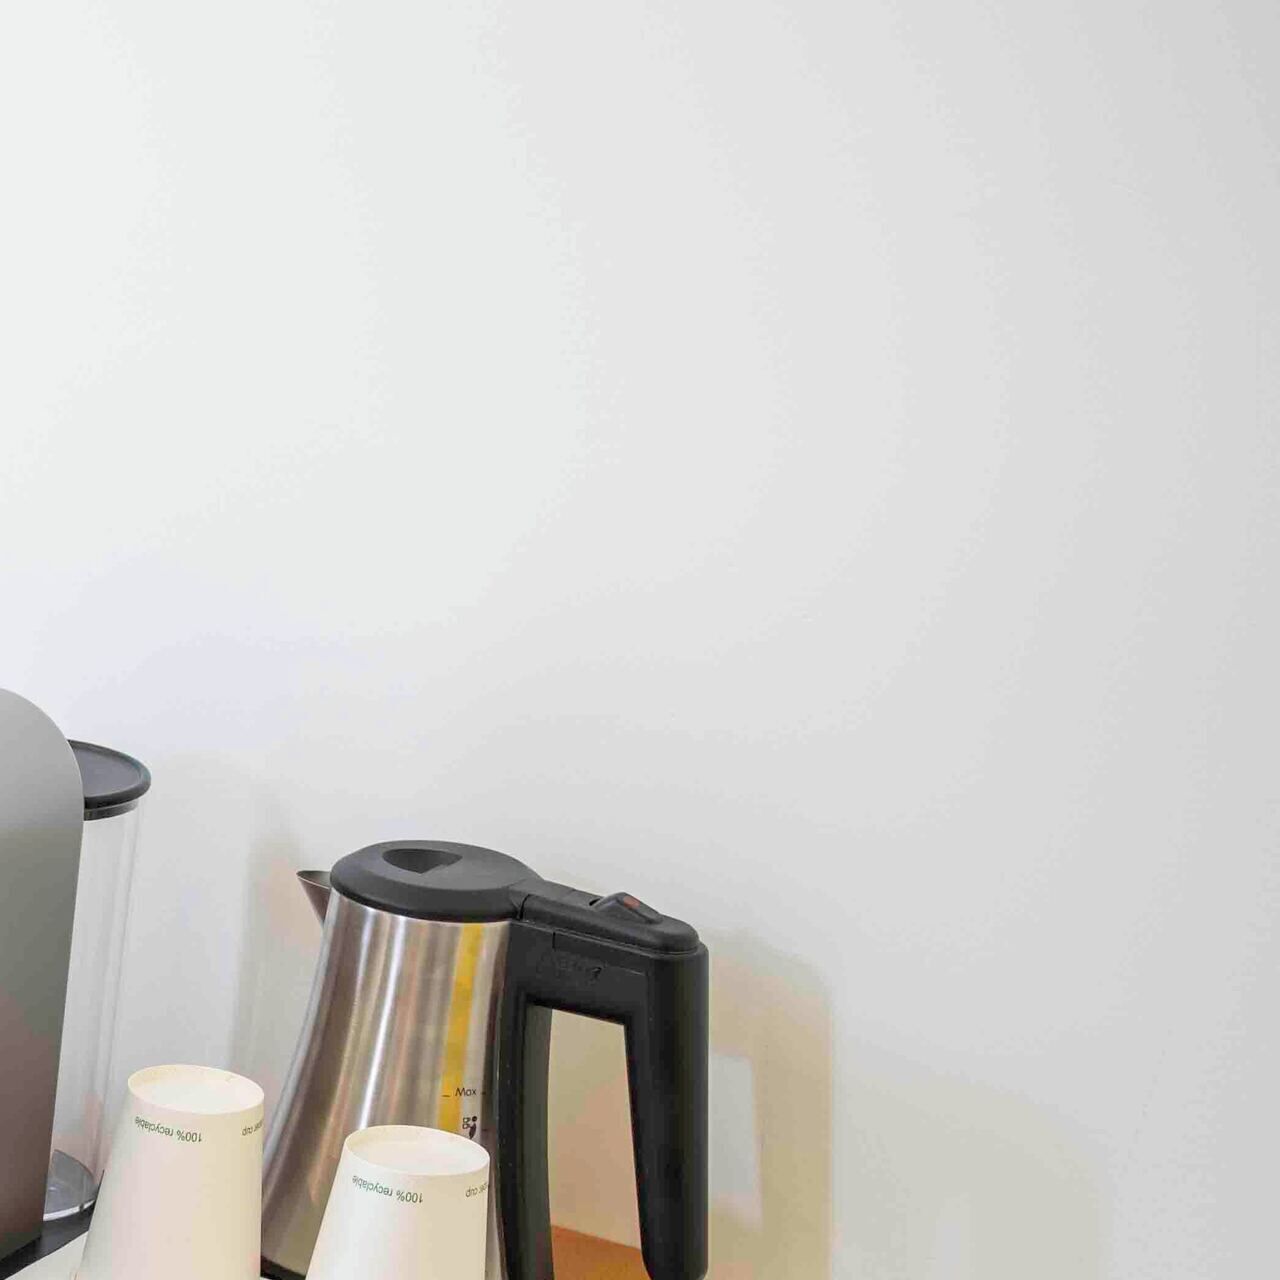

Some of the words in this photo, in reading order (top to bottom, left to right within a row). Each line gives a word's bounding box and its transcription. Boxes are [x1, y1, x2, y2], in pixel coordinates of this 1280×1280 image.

[455, 1087, 477, 1097] Max
[135, 1116, 174, 1136] recyclable
[177, 1130, 202, 1142] 100%
[352, 1175, 393, 1197] recyclable
[396, 1190, 423, 1203] 100%
